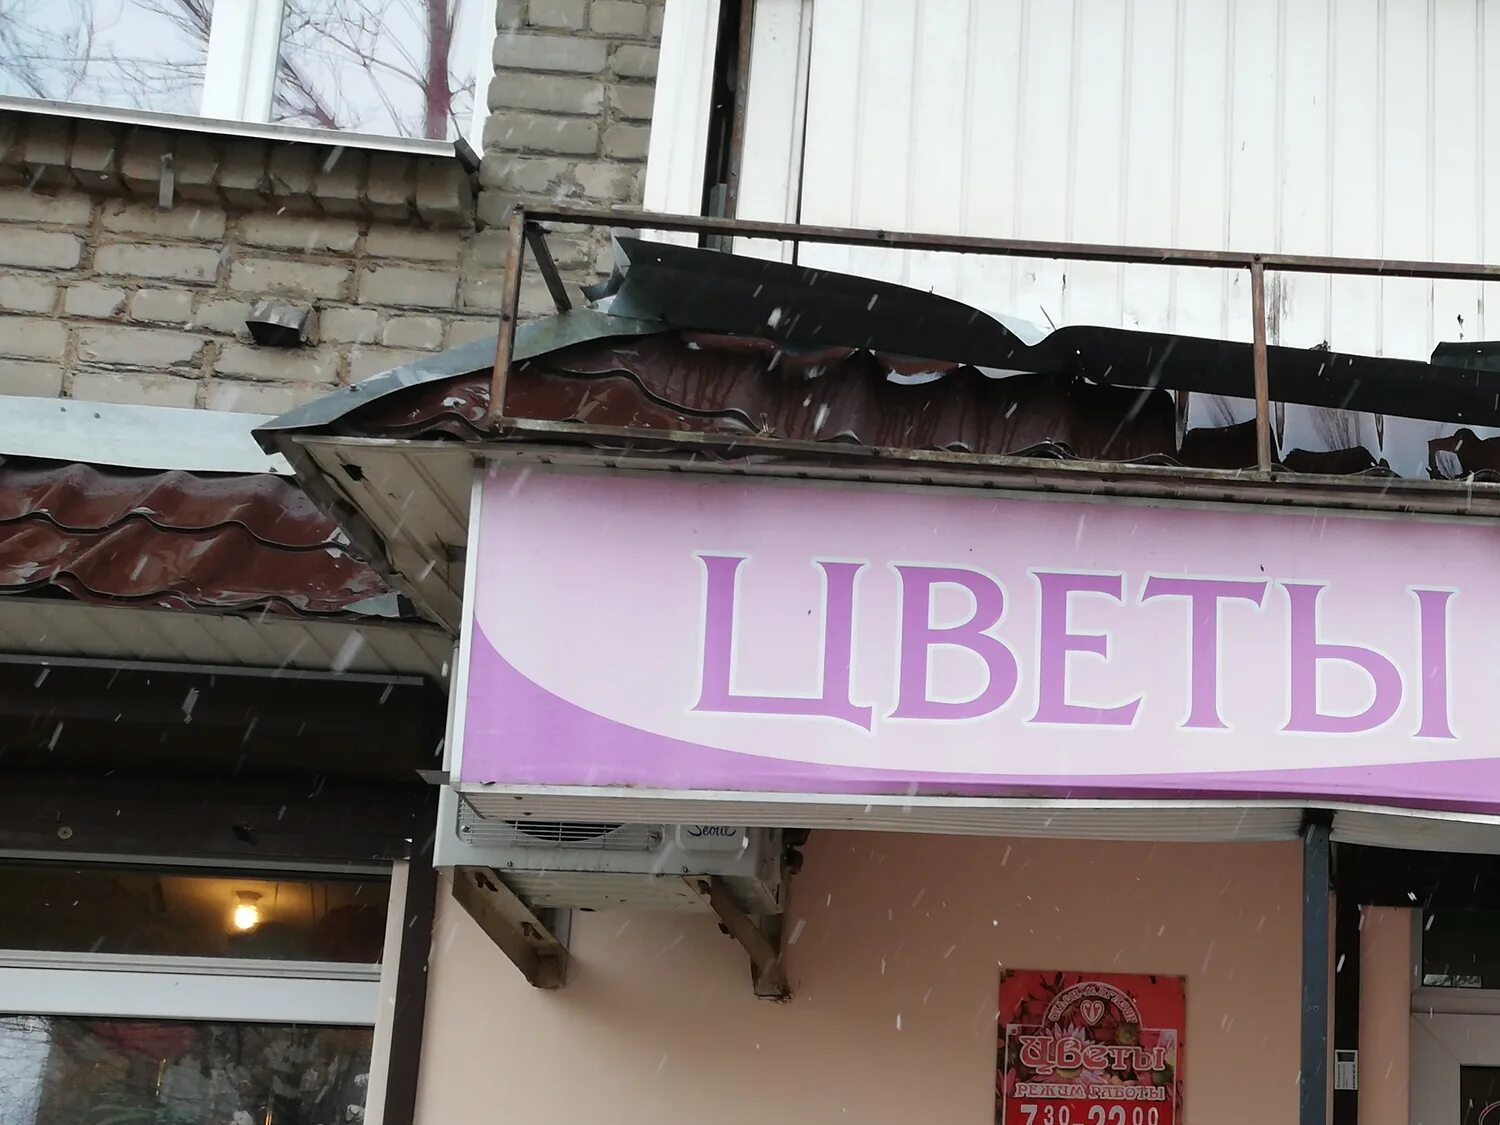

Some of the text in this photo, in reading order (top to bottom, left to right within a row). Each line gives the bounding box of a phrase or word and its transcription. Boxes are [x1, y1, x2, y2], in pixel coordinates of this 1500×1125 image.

[686, 549, 1462, 742] ЦВЕТЫ
[1019, 1035, 1166, 1075] Цветы
[1014, 1082, 1166, 1101] РЕЖИМ РАБОТЫ
